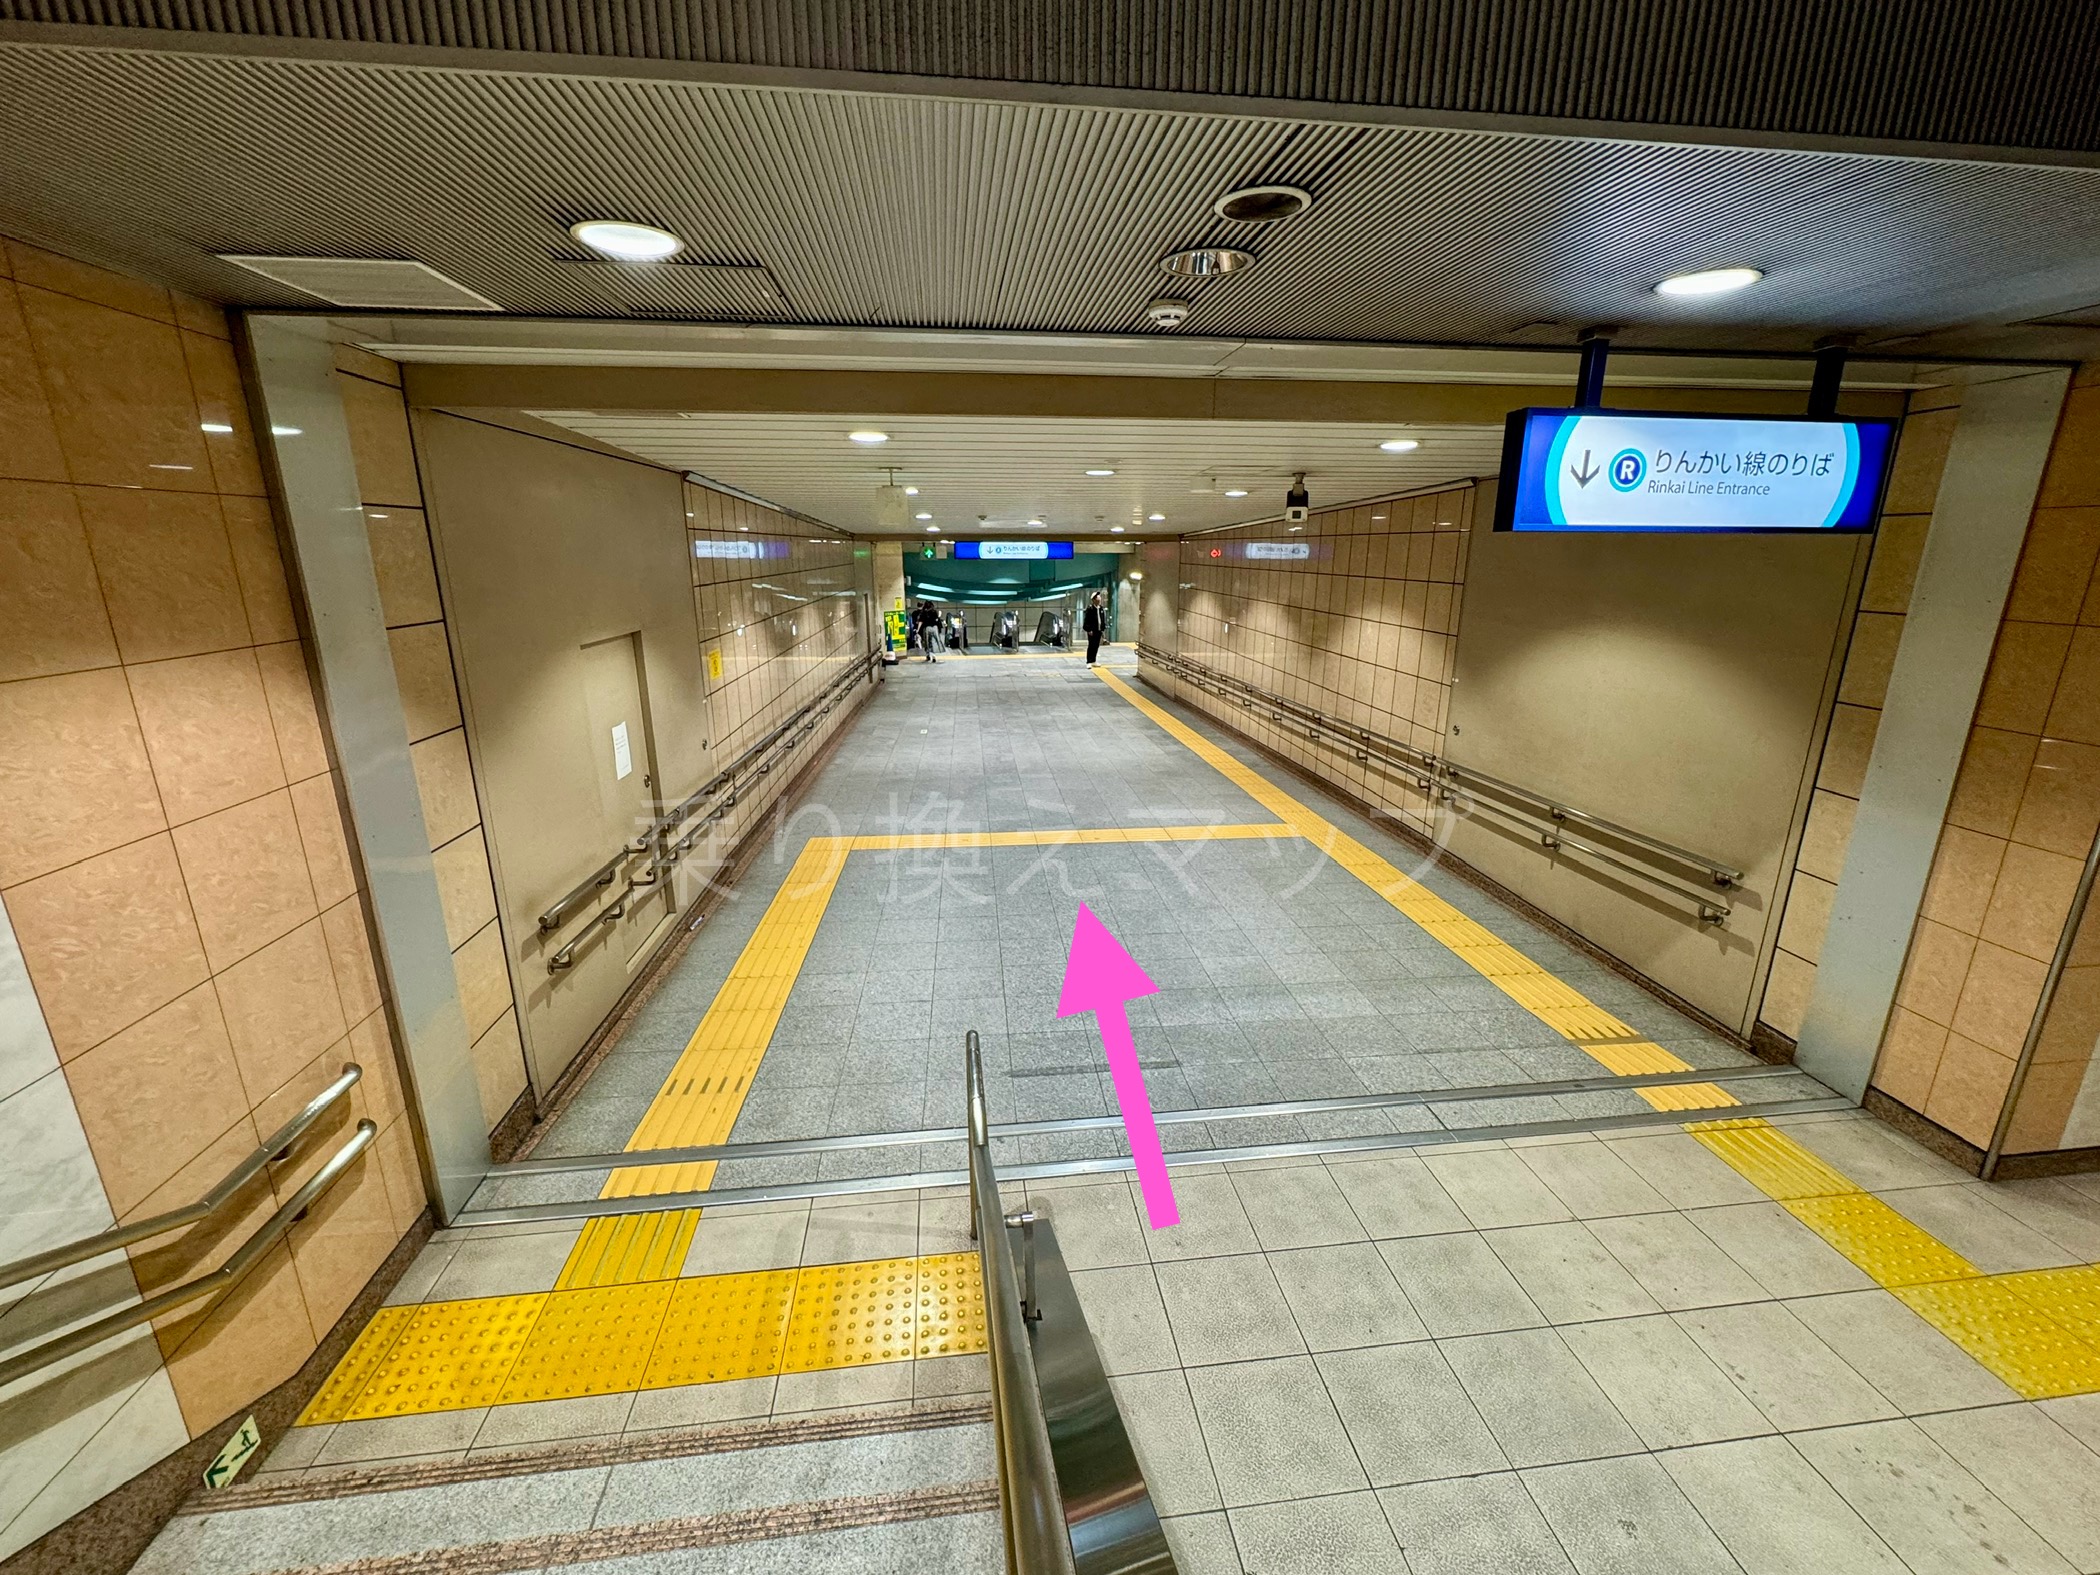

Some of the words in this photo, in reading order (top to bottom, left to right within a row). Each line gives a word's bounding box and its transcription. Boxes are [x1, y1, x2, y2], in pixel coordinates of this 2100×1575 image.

[1655, 449, 1835, 477] りんかい線のりば
[1647, 479, 1685, 494] Rinkai
[1688, 480, 1714, 495] Line
[1717, 482, 1770, 496] Entrance
